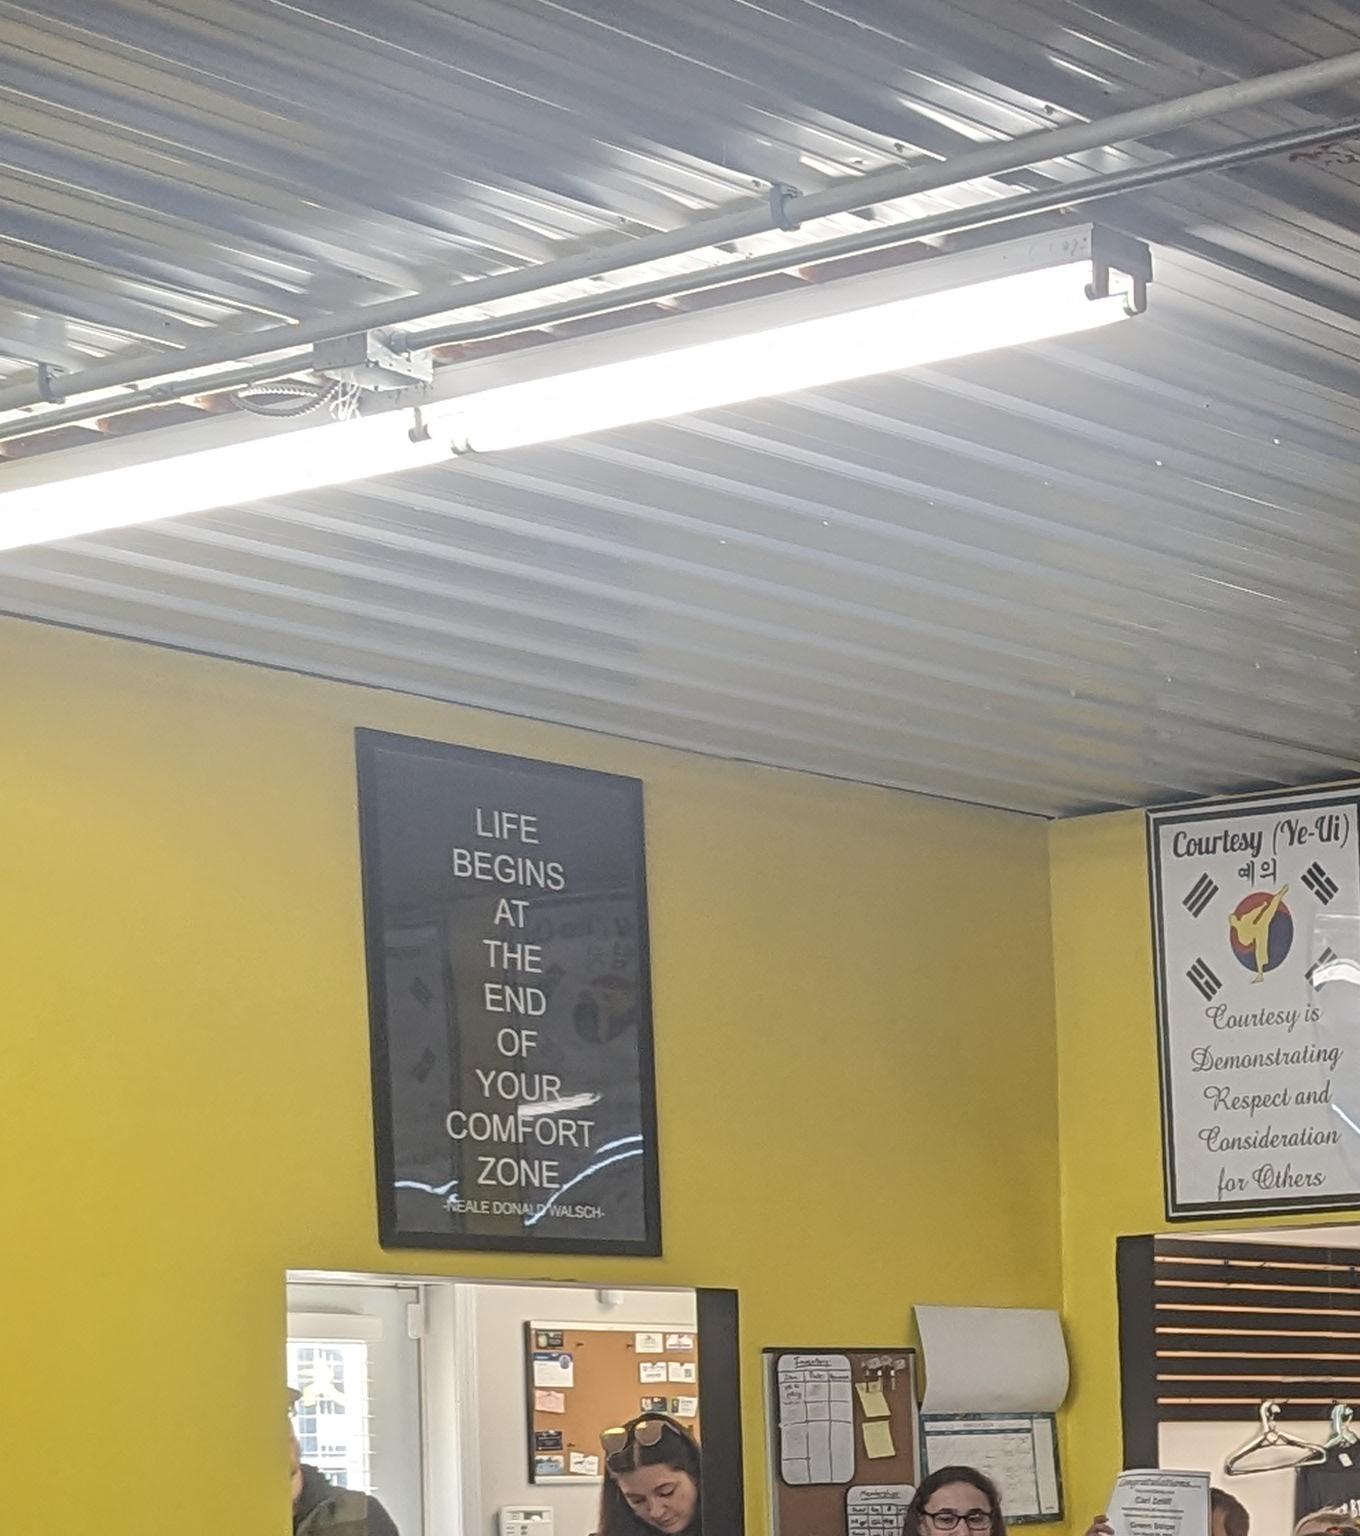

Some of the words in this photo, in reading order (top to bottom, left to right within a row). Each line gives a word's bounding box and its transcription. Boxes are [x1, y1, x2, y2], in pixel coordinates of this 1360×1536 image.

[476, 808, 538, 844] LIFE
[1173, 829, 1263, 858] Courtesy
[1273, 813, 1349, 856] (Ye-Ui)
[453, 849, 564, 889] BEGINS
[1238, 857, 1277, 888] 예의
[494, 899, 528, 927] AT
[483, 940, 542, 973] THE
[485, 984, 545, 1016] END
[1205, 1004, 1300, 1032] Courtesy
[1305, 1003, 1323, 1022] is
[497, 1029, 537, 1057] OF
[1191, 1041, 1343, 1072] Demonstrating
[475, 1069, 561, 1101] YOUR
[1203, 1085, 1290, 1117] Respect
[1295, 1081, 1332, 1105] and
[446, 1110, 594, 1148] COMFORT
[1198, 1125, 1341, 1153] Consideration
[477, 1157, 560, 1188] ZONE
[1218, 1167, 1248, 1199] for
[1251, 1163, 1326, 1190] Others
